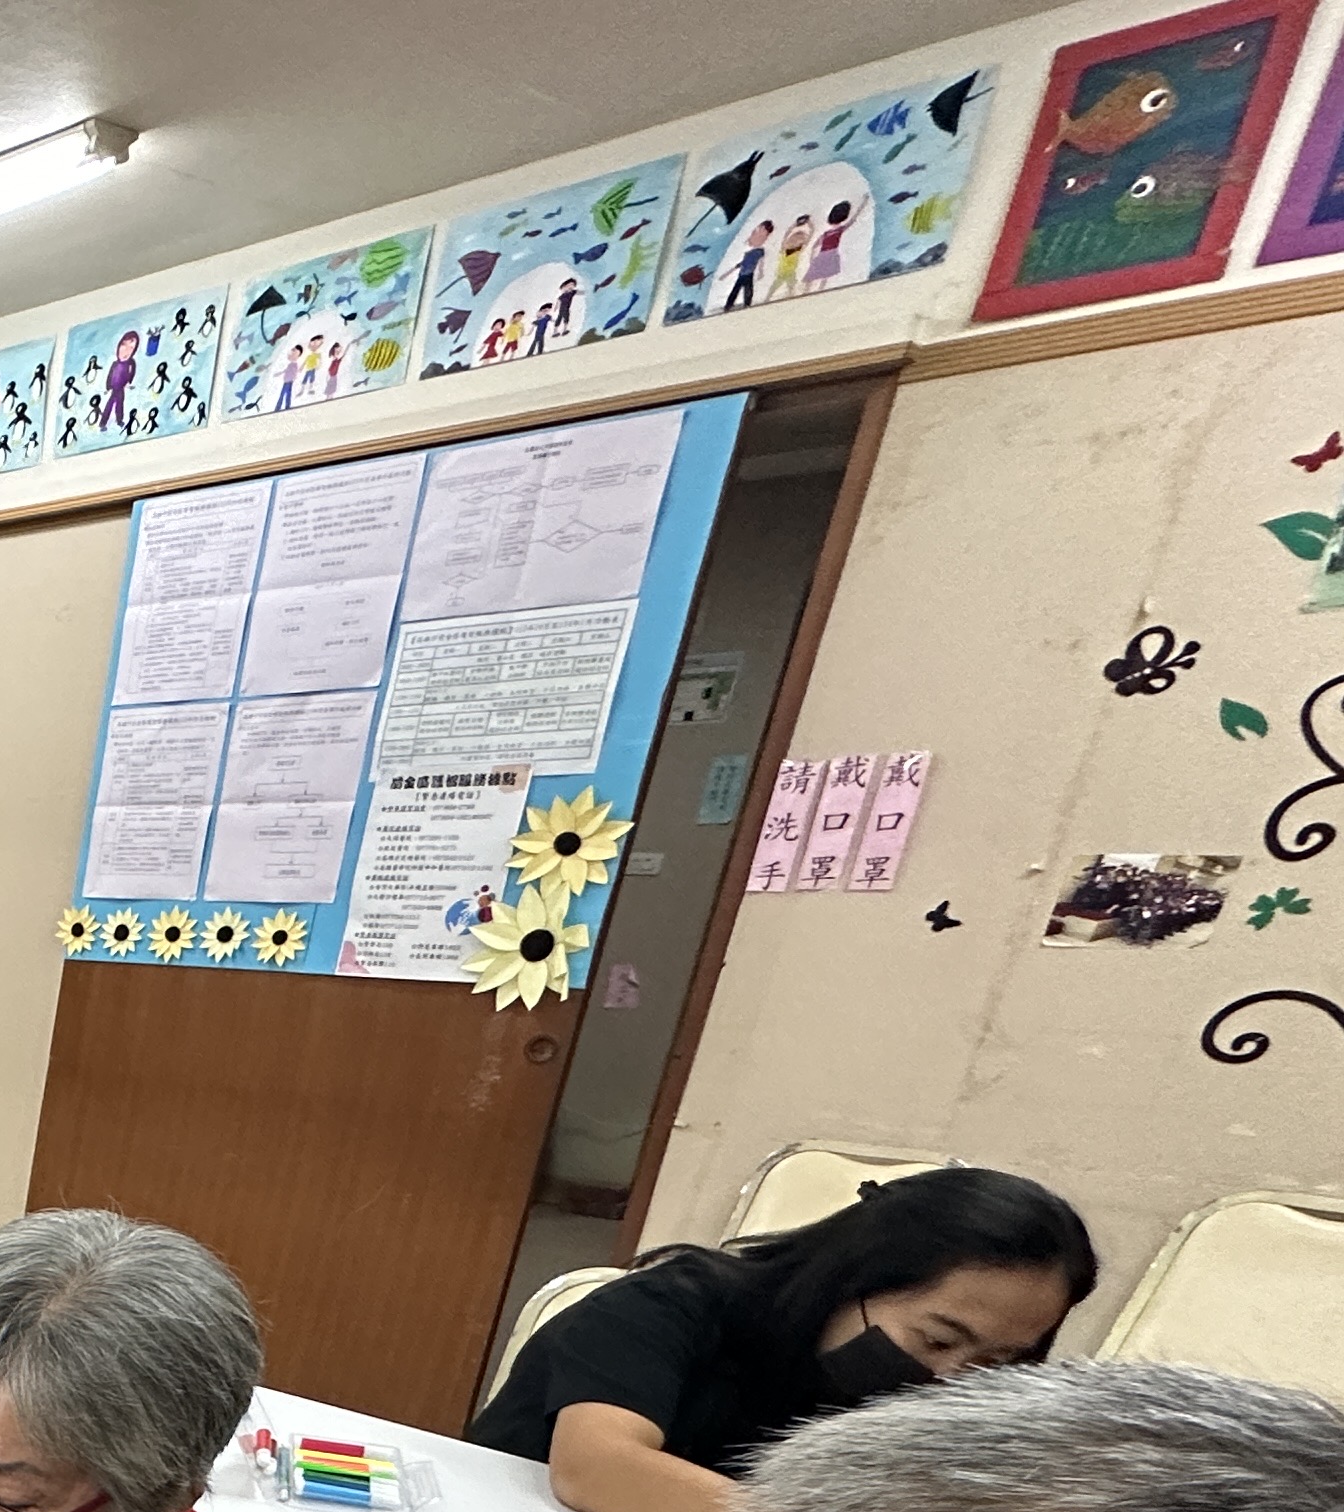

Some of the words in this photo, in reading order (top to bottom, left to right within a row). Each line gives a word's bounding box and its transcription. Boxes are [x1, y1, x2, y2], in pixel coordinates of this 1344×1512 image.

[755, 763, 817, 891] 請洗手
[800, 755, 870, 887] 戴口罩
[856, 754, 923, 889] 戴口罩
